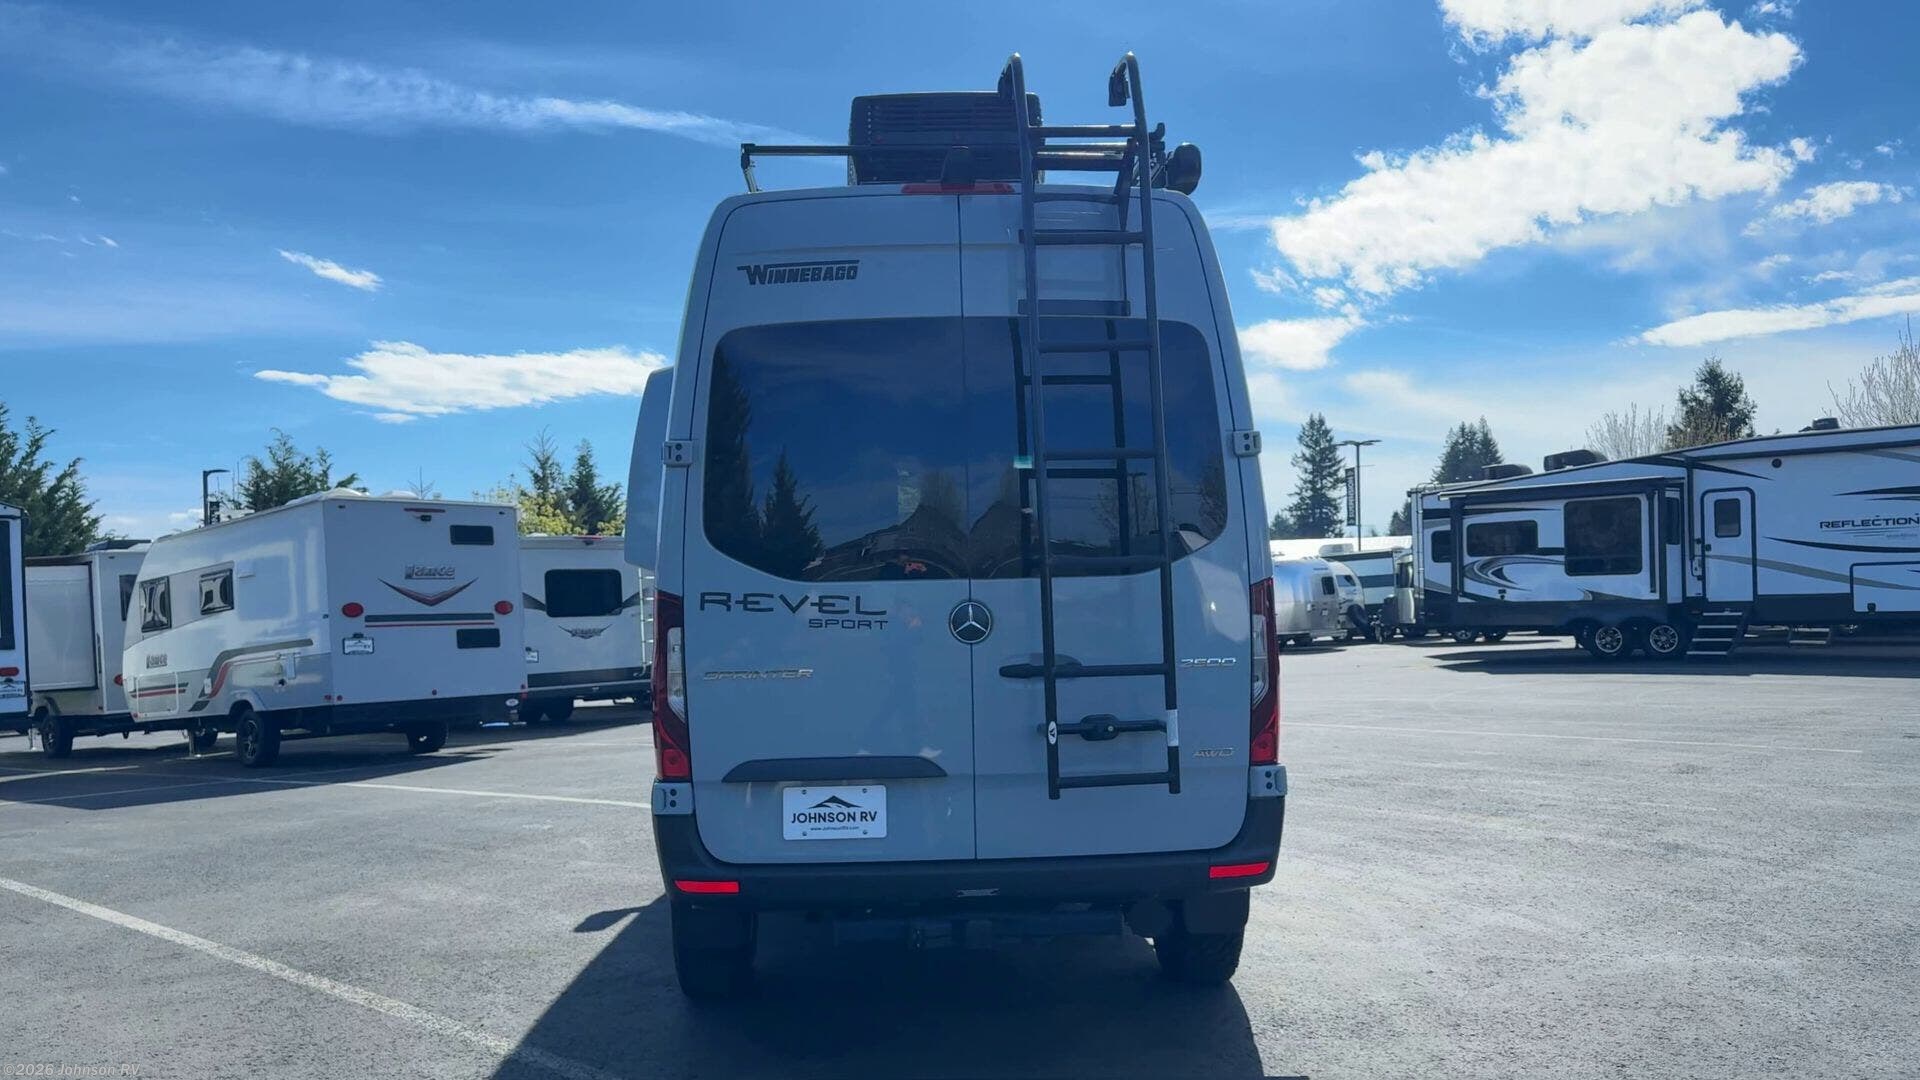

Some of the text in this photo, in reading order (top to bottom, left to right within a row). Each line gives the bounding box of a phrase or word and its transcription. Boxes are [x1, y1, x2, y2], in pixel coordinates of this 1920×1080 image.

[737, 259, 860, 285] WINNEBAGO
[1819, 516, 1920, 529] REFLECTION
[700, 591, 887, 616] REVEL
[808, 618, 889, 631] SPORT
[703, 668, 815, 681] SPRINTER
[791, 810, 878, 824] JOHNSON RV
